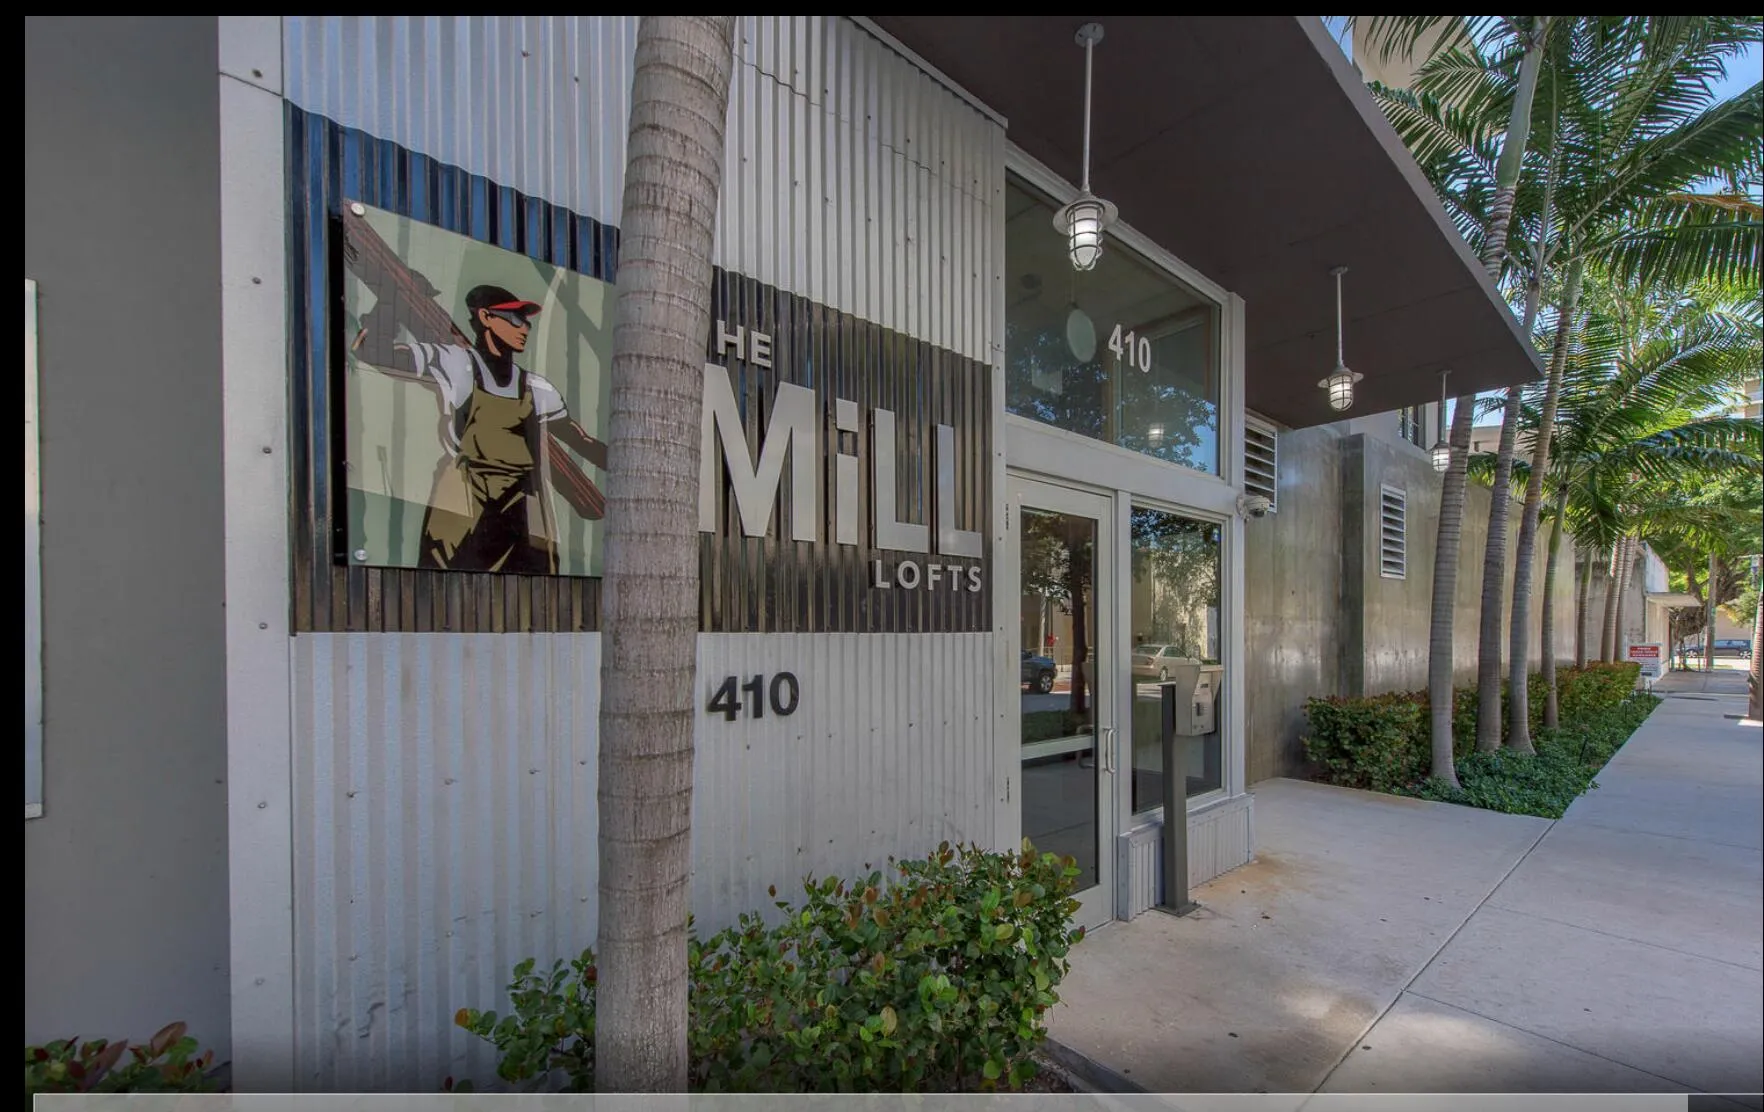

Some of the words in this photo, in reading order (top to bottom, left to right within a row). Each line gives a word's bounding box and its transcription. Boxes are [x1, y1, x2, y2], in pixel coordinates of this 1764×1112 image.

[716, 319, 772, 368] HE
[1108, 323, 1151, 373] 410
[875, 559, 982, 592] LOFTS
[707, 671, 800, 721] 410
